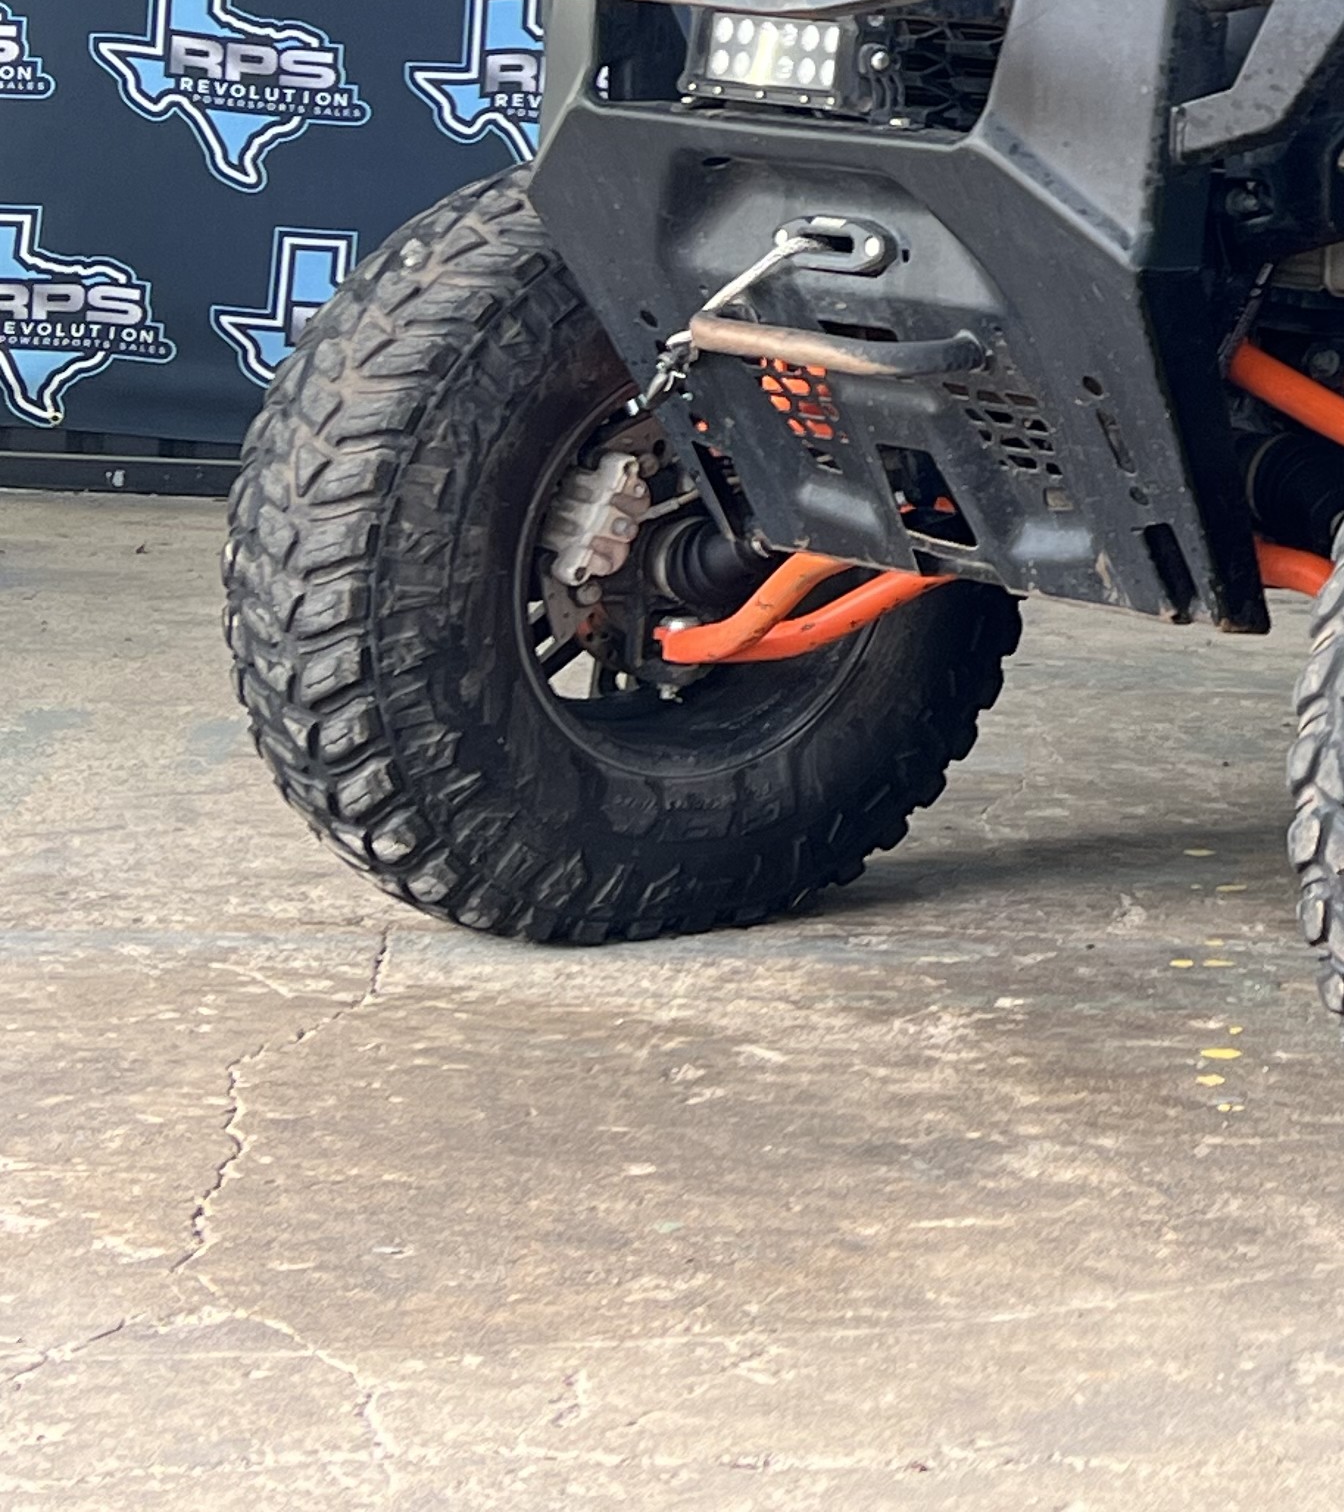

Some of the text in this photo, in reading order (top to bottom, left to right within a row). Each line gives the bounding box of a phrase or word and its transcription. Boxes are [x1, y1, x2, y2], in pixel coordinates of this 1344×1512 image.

[169, 35, 336, 89] RPS
[180, 77, 348, 106] REVOLUTION
[192, 93, 360, 118] POWERSPORTS SALES
[3, 321, 154, 343] EVOLUTION
[119, 341, 167, 355] SALES
